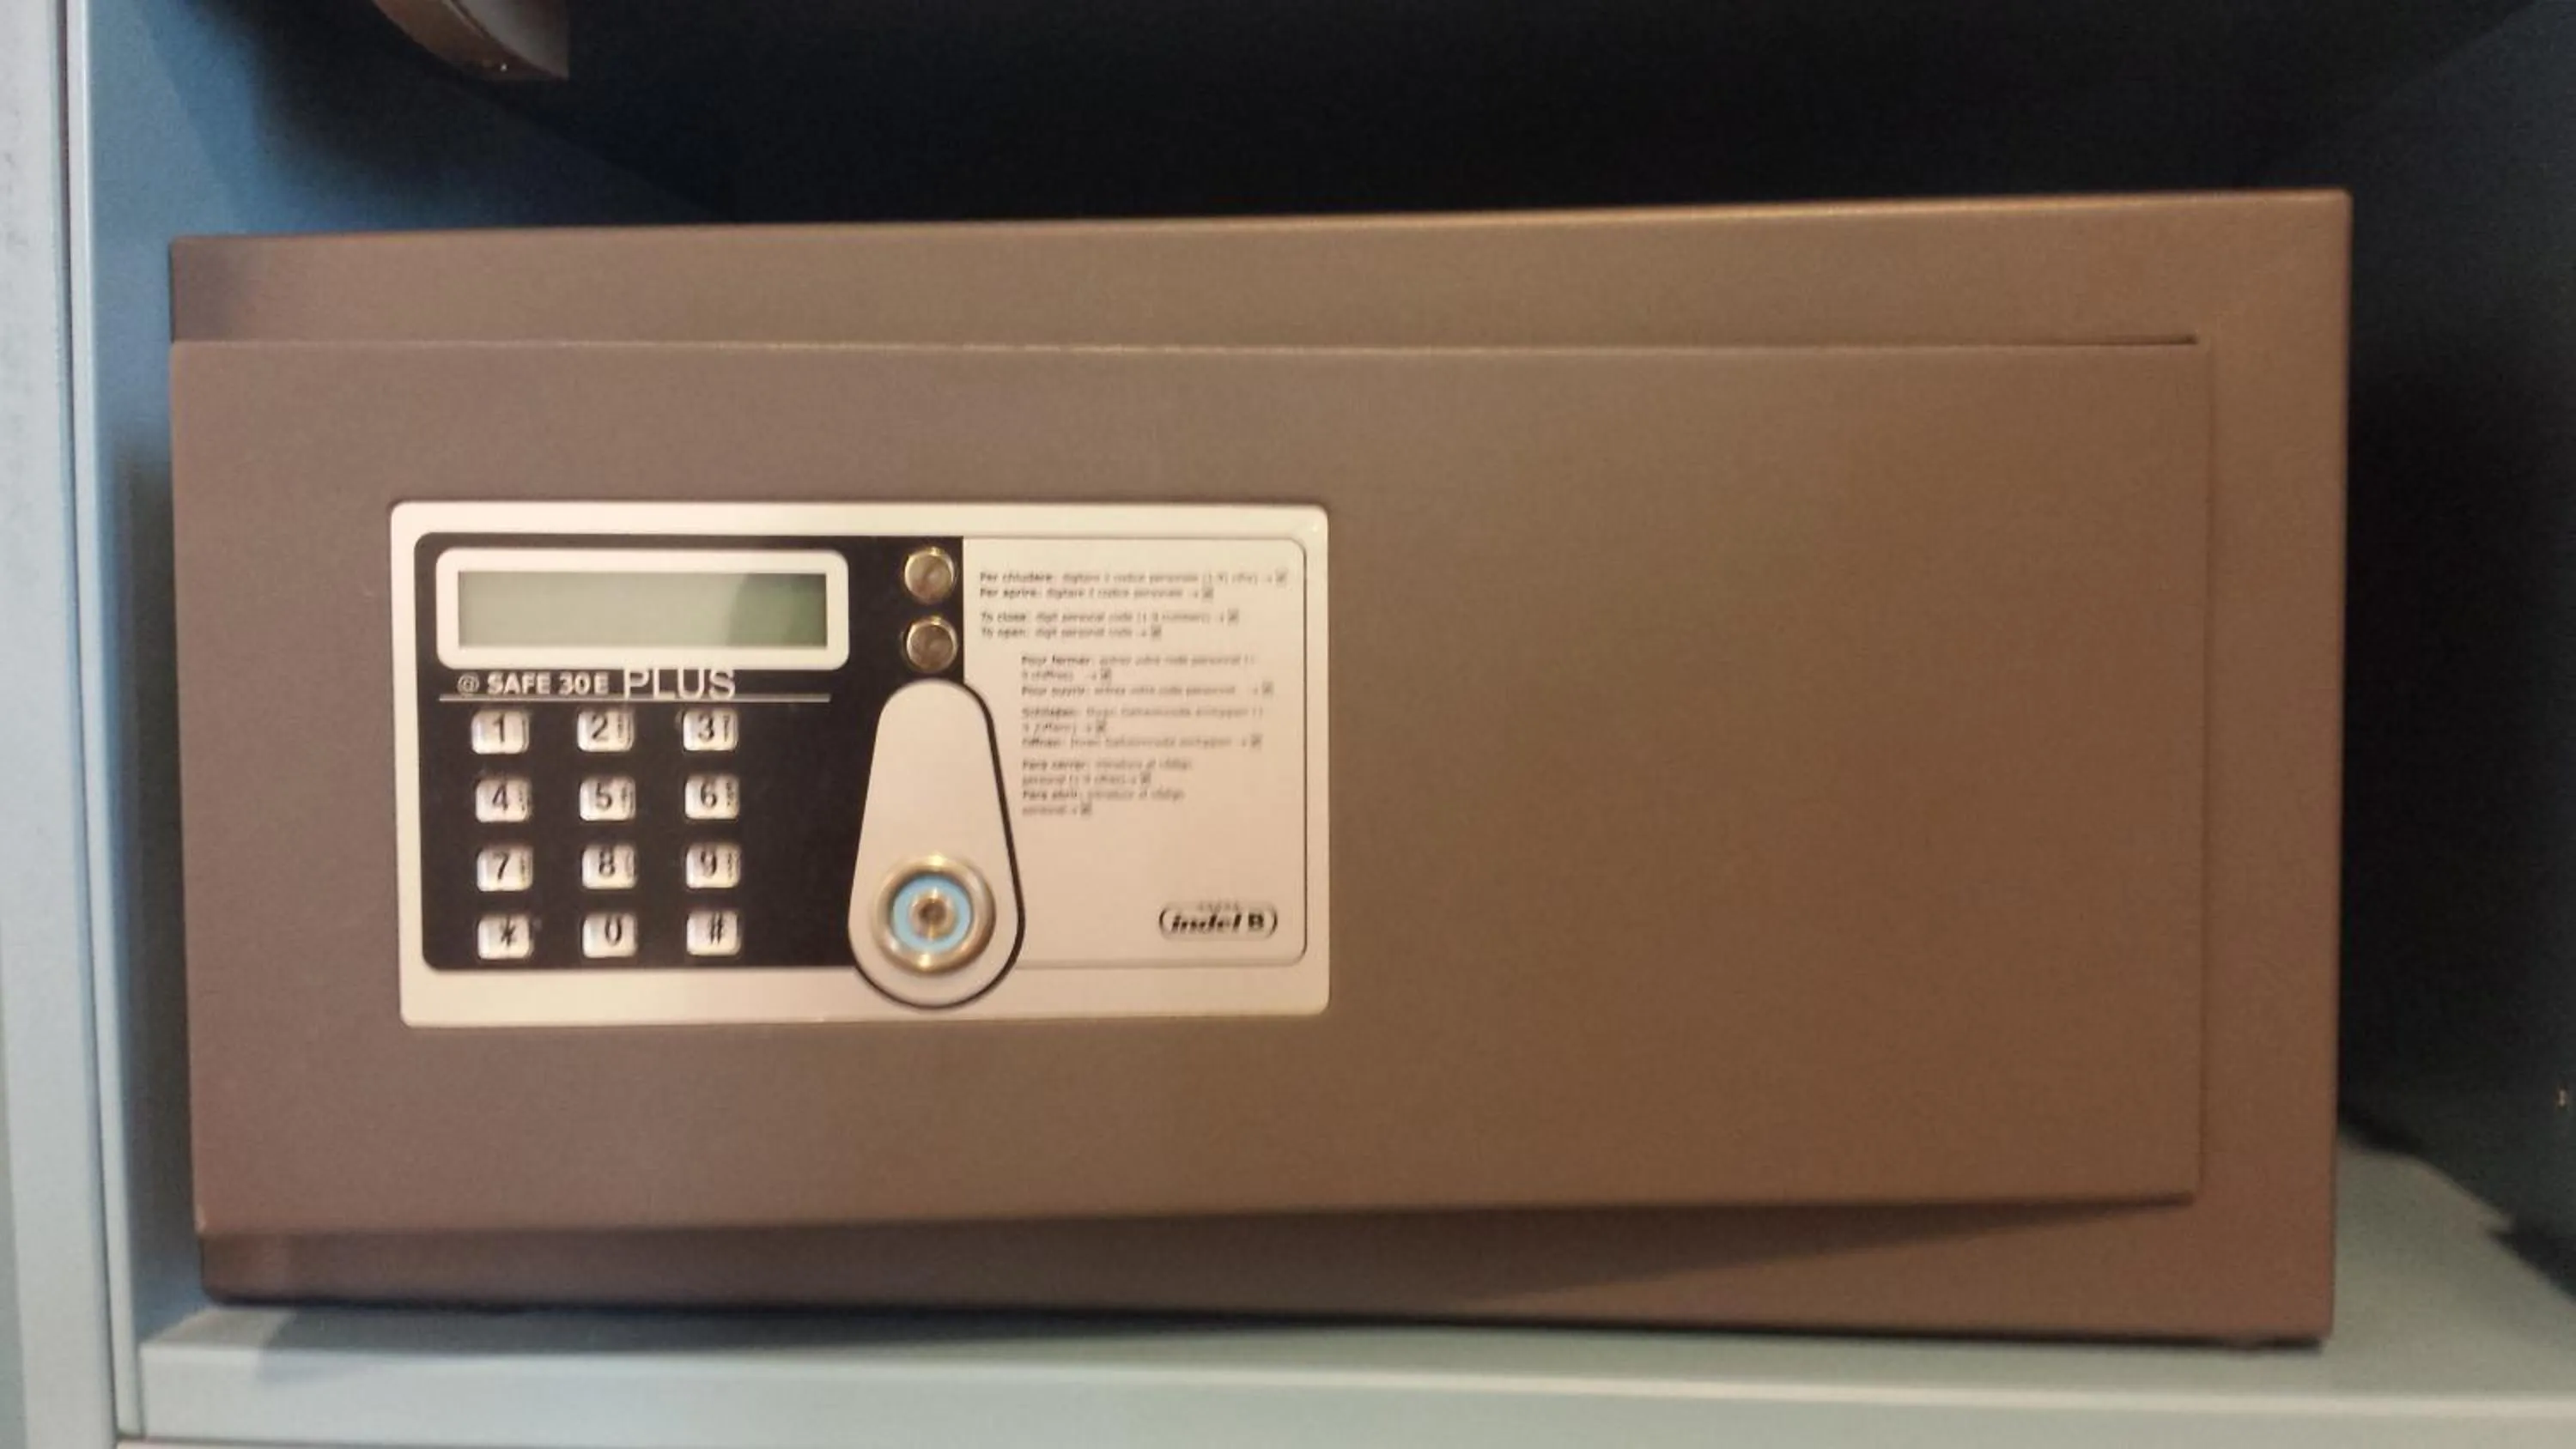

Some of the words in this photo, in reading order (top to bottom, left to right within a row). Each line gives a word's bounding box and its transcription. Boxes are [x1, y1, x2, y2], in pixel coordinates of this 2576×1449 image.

[487, 671, 551, 695] SAFE
[623, 667, 736, 700] PLUS
[492, 713, 507, 743] 1
[591, 713, 609, 743] 2
[697, 713, 715, 742] 3
[492, 782, 509, 811] 4
[595, 781, 613, 811] 5
[699, 781, 718, 809] 6
[492, 850, 509, 881] 7
[598, 850, 616, 878] 8
[699, 850, 718, 878] 9
[604, 915, 623, 944] 0
